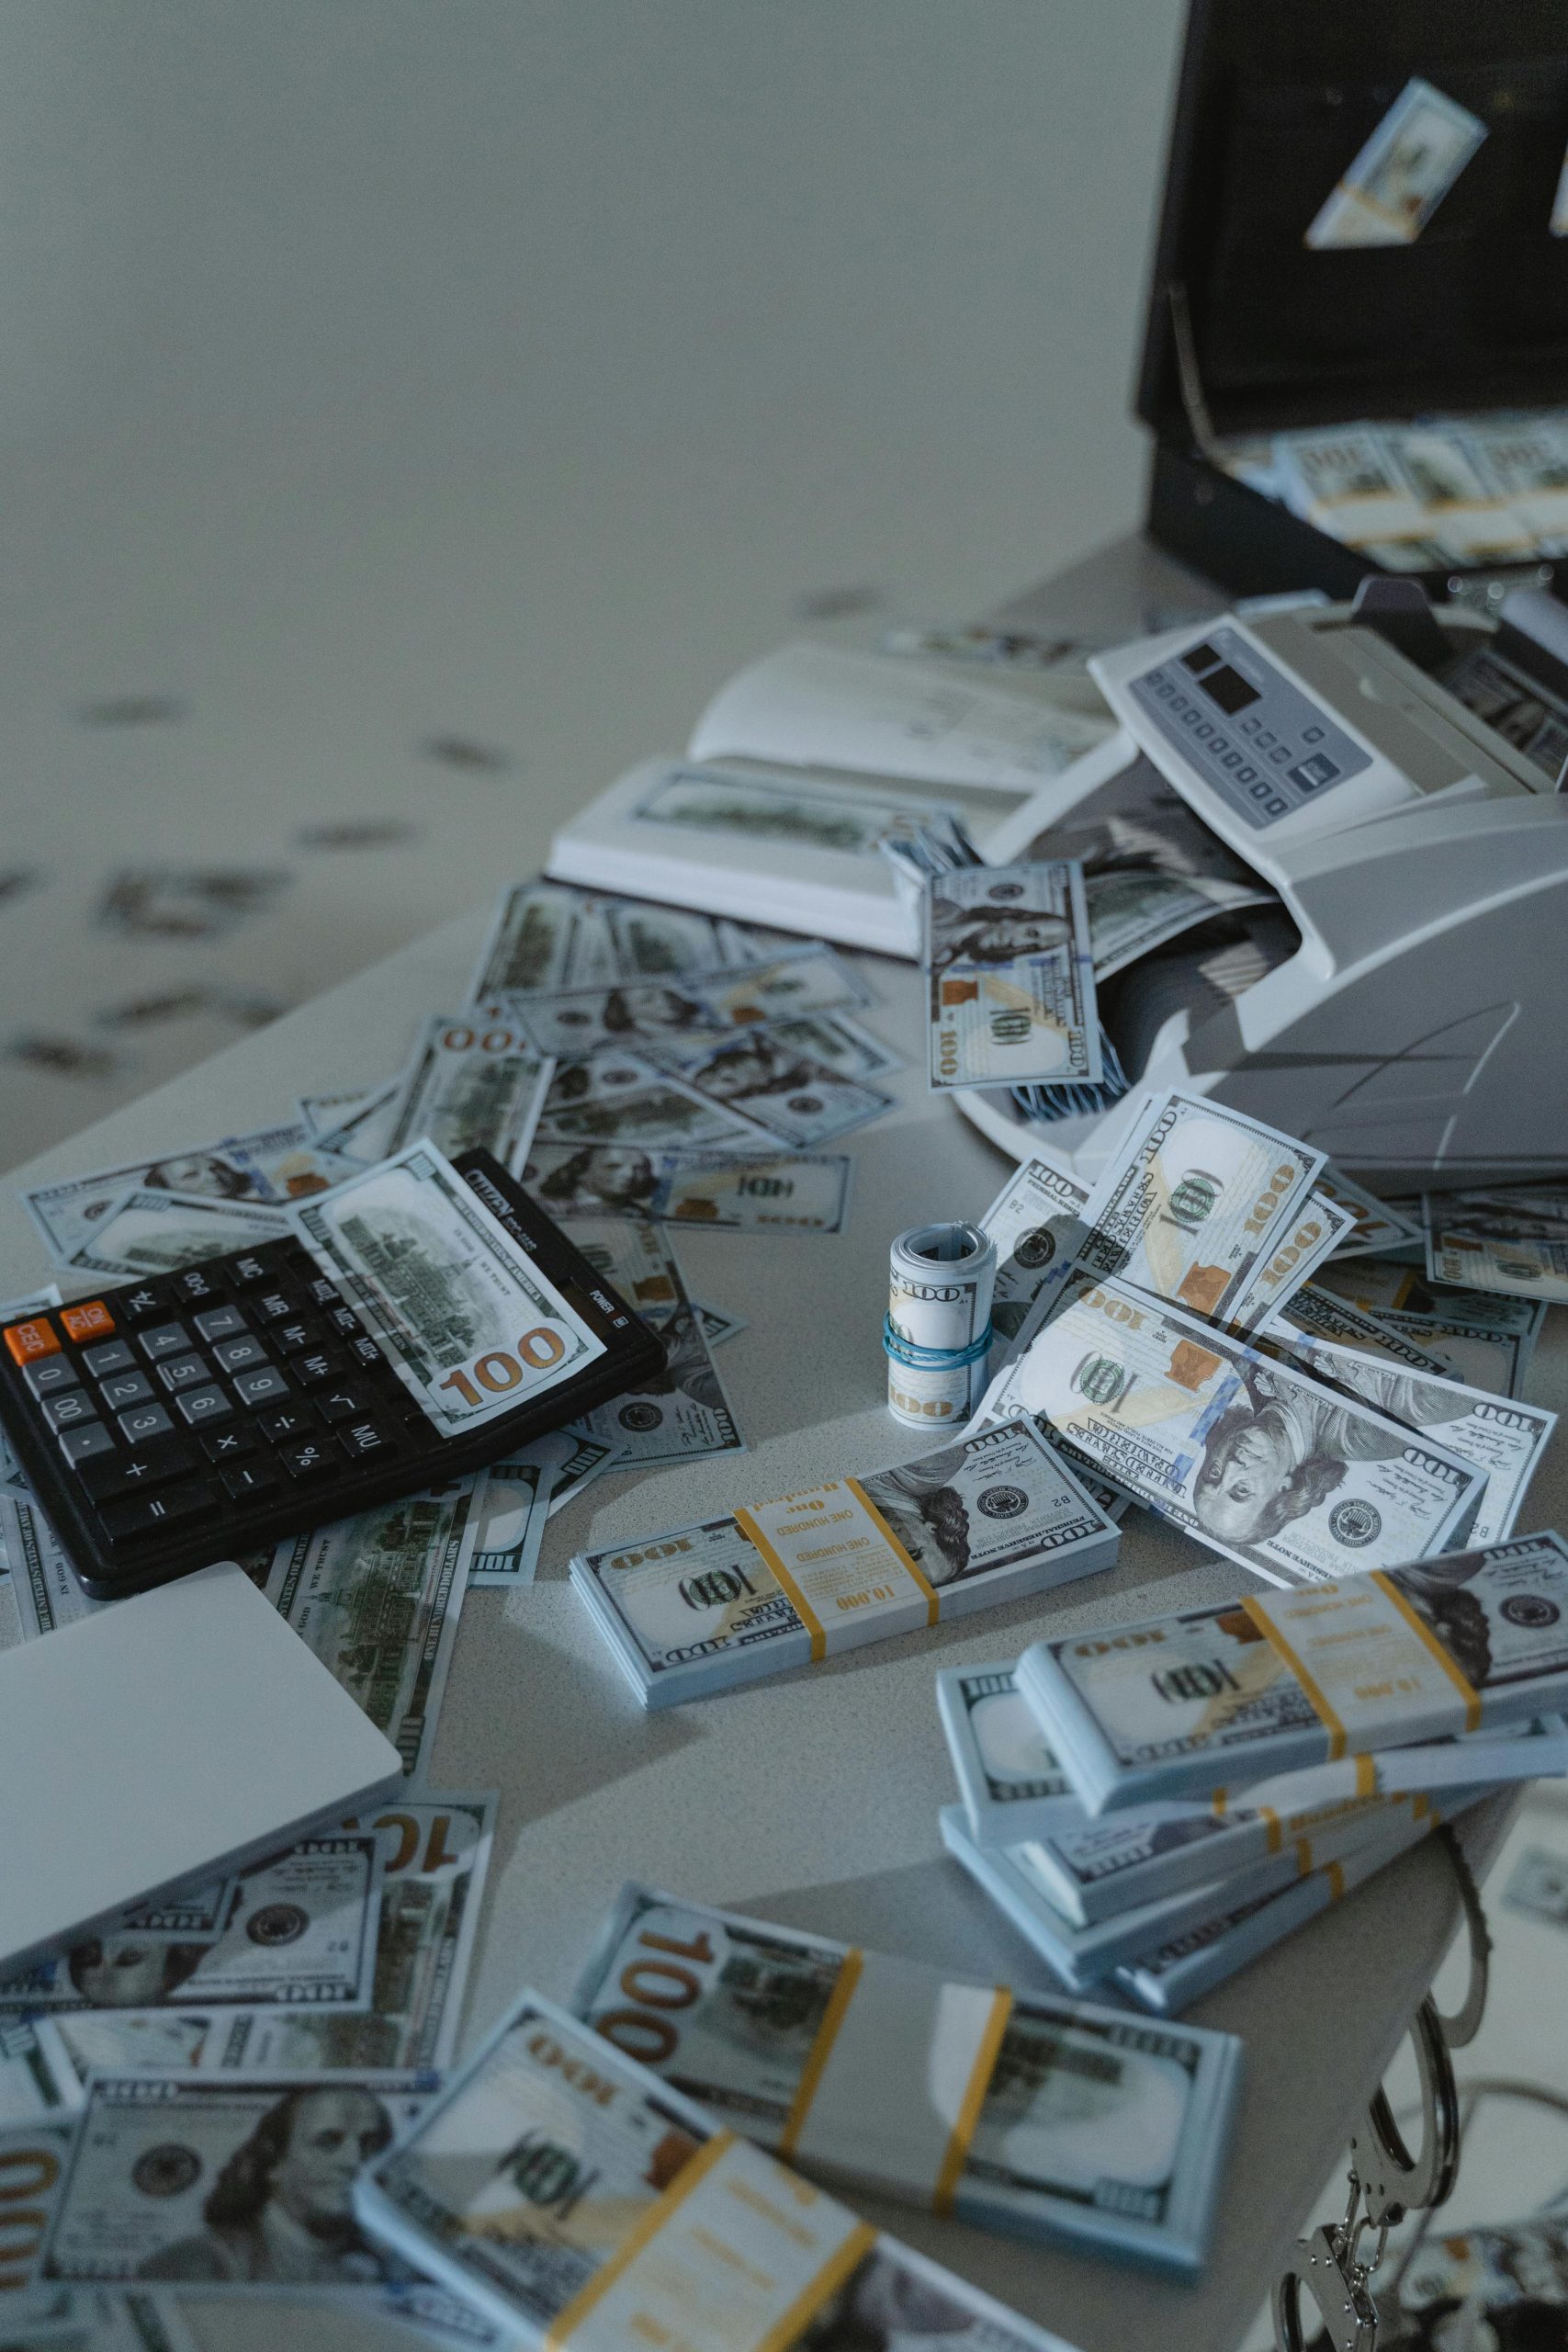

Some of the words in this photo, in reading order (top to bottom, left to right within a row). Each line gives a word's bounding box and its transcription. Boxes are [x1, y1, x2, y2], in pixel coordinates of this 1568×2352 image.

[940, 1030, 958, 1076] 100
[1140, 1112, 1178, 1164] 100
[1029, 1164, 1074, 1198] 100
[466, 1170, 514, 1218] CITIZEN
[1111, 1170, 1154, 1236] STATES
[1244, 1164, 1295, 1238] 100
[1009, 1199, 1025, 1214] B2
[1260, 1222, 1321, 1289] 100
[236, 1258, 263, 1278] MC
[590, 1289, 615, 1314] POWER
[903, 1281, 960, 1302] 100
[89, 1308, 106, 1324] ON
[262, 1294, 289, 1316] MR
[1078, 1286, 1148, 1330] 100
[68, 1315, 85, 1329] AC
[209, 1315, 233, 1328] 7
[17, 1325, 44, 1352] CE/C
[155, 1336, 176, 1346] 4
[282, 1326, 306, 1344] M-
[1151, 1333, 1167, 1343] SERIES
[98, 1352, 120, 1363] 1
[230, 1347, 252, 1360] 8
[1375, 1338, 1430, 1369] 100
[38, 1368, 62, 1381] 0
[173, 1365, 196, 1377] 5
[304, 1356, 328, 1375] M+
[439, 1327, 565, 1408] 100
[114, 1384, 138, 1396] 2
[249, 1378, 272, 1391] 9
[54, 1398, 83, 1419] 00
[191, 1397, 216, 1409] 6
[133, 1416, 157, 1430] 3
[1472, 1402, 1534, 1431] 100
[351, 1425, 381, 1448] MU
[964, 1429, 1021, 1453] 100
[1063, 1420, 1129, 1464] STATES
[1082, 1417, 1162, 1467] AMERICA
[1101, 1454, 1140, 1480] THE
[1122, 1455, 1190, 1498] UNITED
[1156, 1457, 1181, 1478] OF
[1402, 1448, 1461, 1486] 100
[786, 1498, 826, 1514] One
[1053, 1495, 1072, 1508] B2
[777, 1516, 830, 1536] HUNDRED
[831, 1510, 853, 1525] ONE
[1055, 1516, 1086, 1532] FEDERAL
[1173, 1508, 1200, 1527] ONE
[1041, 1521, 1098, 1549] 100
[1470, 1521, 1489, 1538] B2
[850, 1536, 871, 1551] ONE
[997, 1528, 1056, 1554] RESERVE
[1267, 1539, 1291, 1558] NOTE
[23, 1540, 42, 1577] STATES
[314, 1537, 331, 1571] TRUST
[438, 1538, 460, 1589] DOLLARS
[611, 1539, 694, 1570] 100
[797, 1543, 848, 1562] HUNDRED
[971, 1547, 997, 1560] NOTE
[54, 1562, 66, 1581] GOD
[309, 1571, 321, 1589] WE
[30, 1576, 50, 1614] UNITED
[60, 1583, 69, 1594] IN
[276, 1573, 299, 1618] STATES
[678, 1565, 758, 1611] 100
[298, 1605, 311, 1628] GOD
[427, 1587, 449, 1637] HUNDRED
[423, 1635, 437, 1660] ONE
[666, 1635, 732, 1663] 100
[594, 1930, 716, 2065] 100
